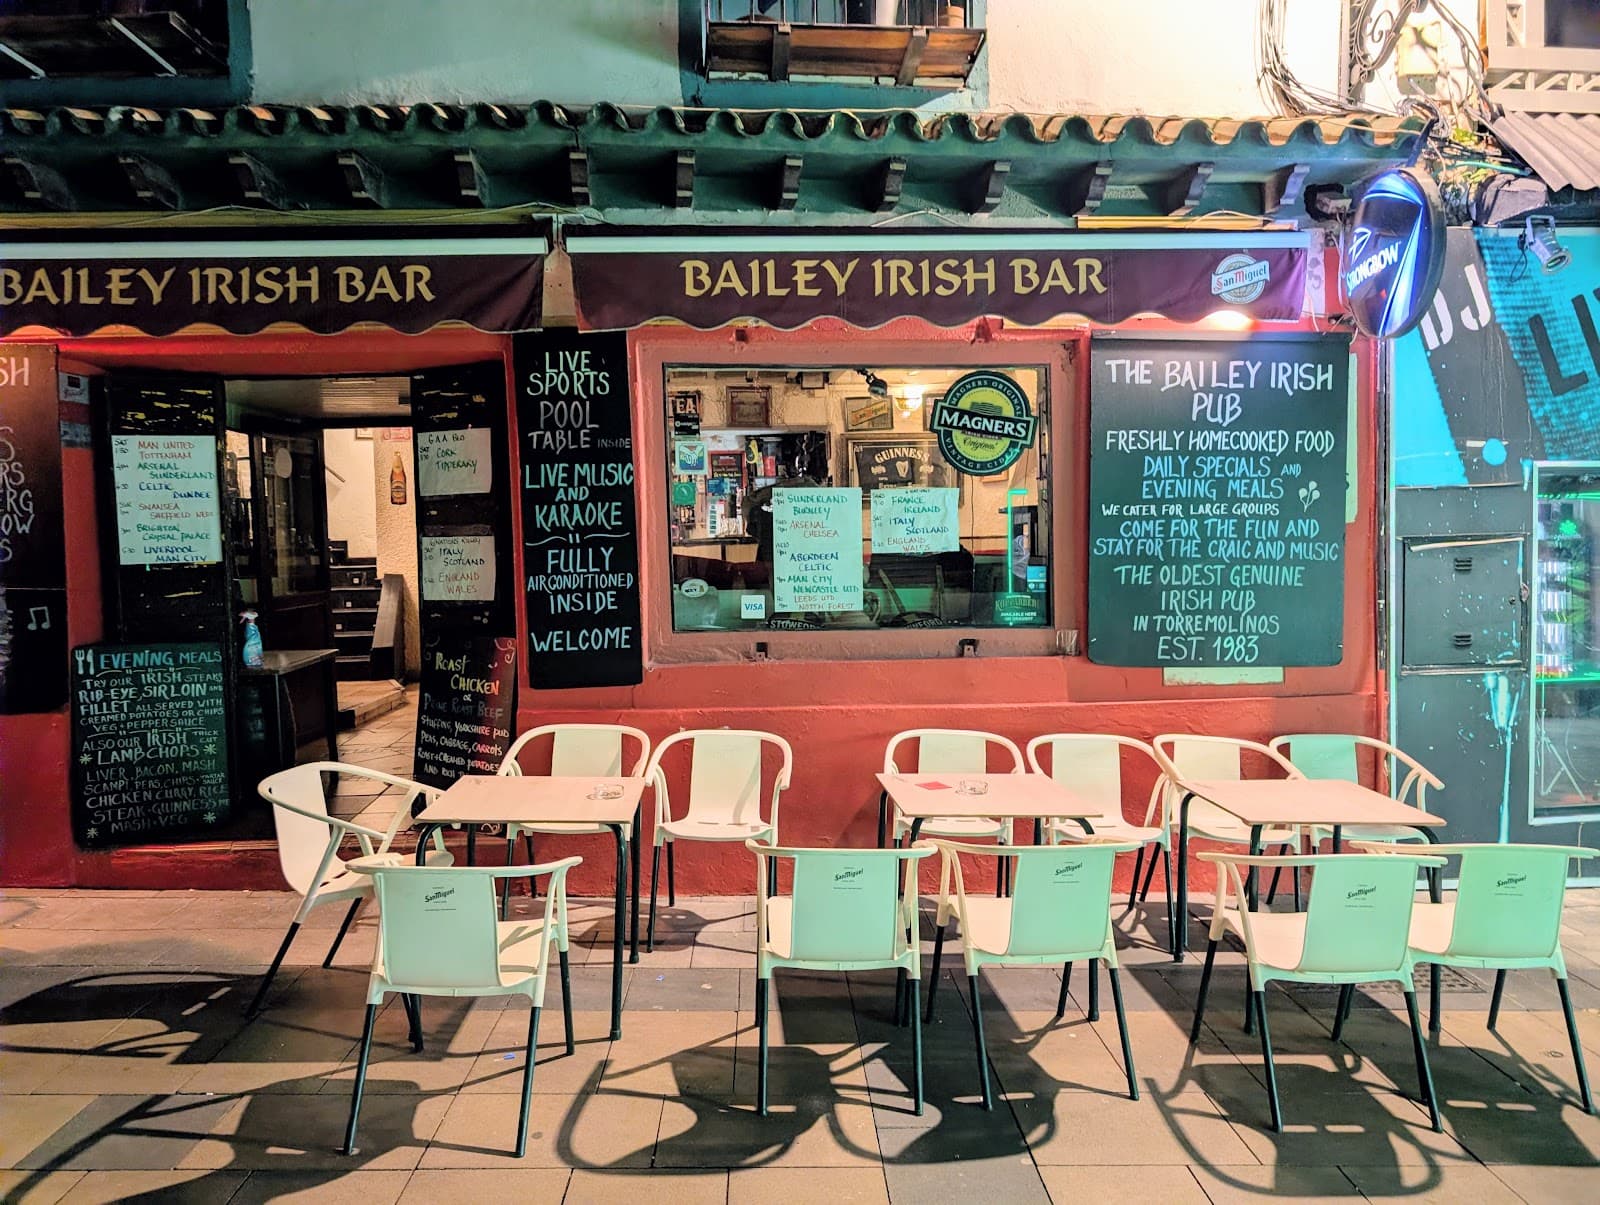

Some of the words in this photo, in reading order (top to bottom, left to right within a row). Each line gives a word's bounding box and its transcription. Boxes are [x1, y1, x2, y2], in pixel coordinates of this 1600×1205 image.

[0, 265, 176, 305] BAILEY
[188, 265, 319, 305] IRISH
[333, 264, 436, 303] BAR
[680, 258, 860, 297] BAILEY
[871, 257, 996, 297] IRISH
[1009, 257, 1108, 296] BAR
[545, 351, 592, 373] LIVE
[526, 370, 610, 399] SPORTS
[1105, 359, 1153, 385] THE
[1161, 360, 1262, 392] BAILEY
[1270, 361, 1333, 396] IRISH
[540, 401, 599, 429] POOL
[1191, 392, 1242, 427] PUB
[940, 408, 1027, 438] MAGNERS
[528, 429, 591, 455] TABLE
[597, 438, 632, 449] INSIDE
[1106, 430, 1184, 454] FRESHLY
[1188, 430, 1289, 457] HOMECOOKED
[1295, 430, 1335, 458] FOOD
[874, 447, 931, 463] GUINNESS
[525, 463, 569, 488] LIVE
[574, 463, 634, 487] MUSIC
[1143, 456, 1190, 478] DAILY
[1193, 456, 1271, 478] SPECIALS
[1281, 463, 1301, 478] AND
[555, 486, 590, 502] AND
[787, 494, 848, 503] SUNDERLAND
[1142, 479, 1217, 501] EVENING
[1227, 478, 1284, 500] MEALS
[535, 502, 623, 532] KARAOKE
[1101, 504, 1120, 516] WE
[1123, 504, 1158, 517] CATER
[1162, 504, 1184, 517] FOR
[1190, 504, 1228, 516] LARGE
[1232, 503, 1280, 517] GROUPS
[790, 519, 826, 529] ARSENAL
[889, 517, 915, 527] ITALY
[1120, 519, 1165, 538] COME
[1170, 519, 1200, 540] FOR
[1204, 518, 1237, 538] THE
[1244, 519, 1279, 540] FUN
[1285, 519, 1319, 538] AND
[547, 546, 614, 574] FULLY
[790, 552, 840, 562] ABERDEEN
[1093, 538, 1135, 555] STAY
[1136, 540, 1165, 561] FOR
[1168, 539, 1201, 559] THE
[1208, 540, 1251, 563] CRAIC
[1255, 541, 1285, 561] AND
[1290, 542, 1339, 561] MUSIC
[798, 563, 832, 571] CELTIC
[1113, 565, 1152, 585] THE
[1160, 565, 1225, 586] OLDEST
[1230, 565, 1305, 587] GENUINE
[446, 584, 478, 594] WALES
[527, 573, 634, 594] AIRCONDITIONED
[550, 591, 618, 615] INSIDE
[744, 603, 763, 611] VISA
[1161, 590, 1212, 616] IRISH
[1221, 590, 1256, 617] PUB
[1133, 616, 1148, 632] IN
[1153, 615, 1280, 635] TORREMOLINOS
[531, 627, 632, 652] WELCOME
[1157, 636, 1205, 661] EST.
[1213, 635, 1259, 663] 1983
[100, 650, 174, 670] EVENING
[179, 651, 222, 664] MEALS
[82, 678, 106, 690] TRY
[110, 677, 133, 687] OUR
[141, 672, 182, 685] IRISH
[184, 673, 223, 683] STEAKS
[142, 683, 207, 699] SIRLOIN
[450, 674, 500, 696] CHICKEN
[80, 700, 131, 716] FILLET
[135, 703, 154, 712] ALL
[155, 701, 193, 711] SERVED
[197, 699, 223, 708] WITH
[80, 713, 126, 726] CREAMED
[129, 709, 179, 719] POTATOES
[197, 707, 224, 716] CHIPS
[92, 722, 117, 732] VEG
[126, 718, 170, 730] PEPPER
[170, 717, 205, 726] SAUCE
[82, 738, 115, 752] ALSO
[117, 737, 140, 749] OUR
[147, 732, 187, 747] IRISH
[97, 748, 144, 765] LAMB
[146, 745, 200, 759] CHOPS
[182, 759, 216, 773] MASH
[86, 790, 152, 809] CHICKEN
